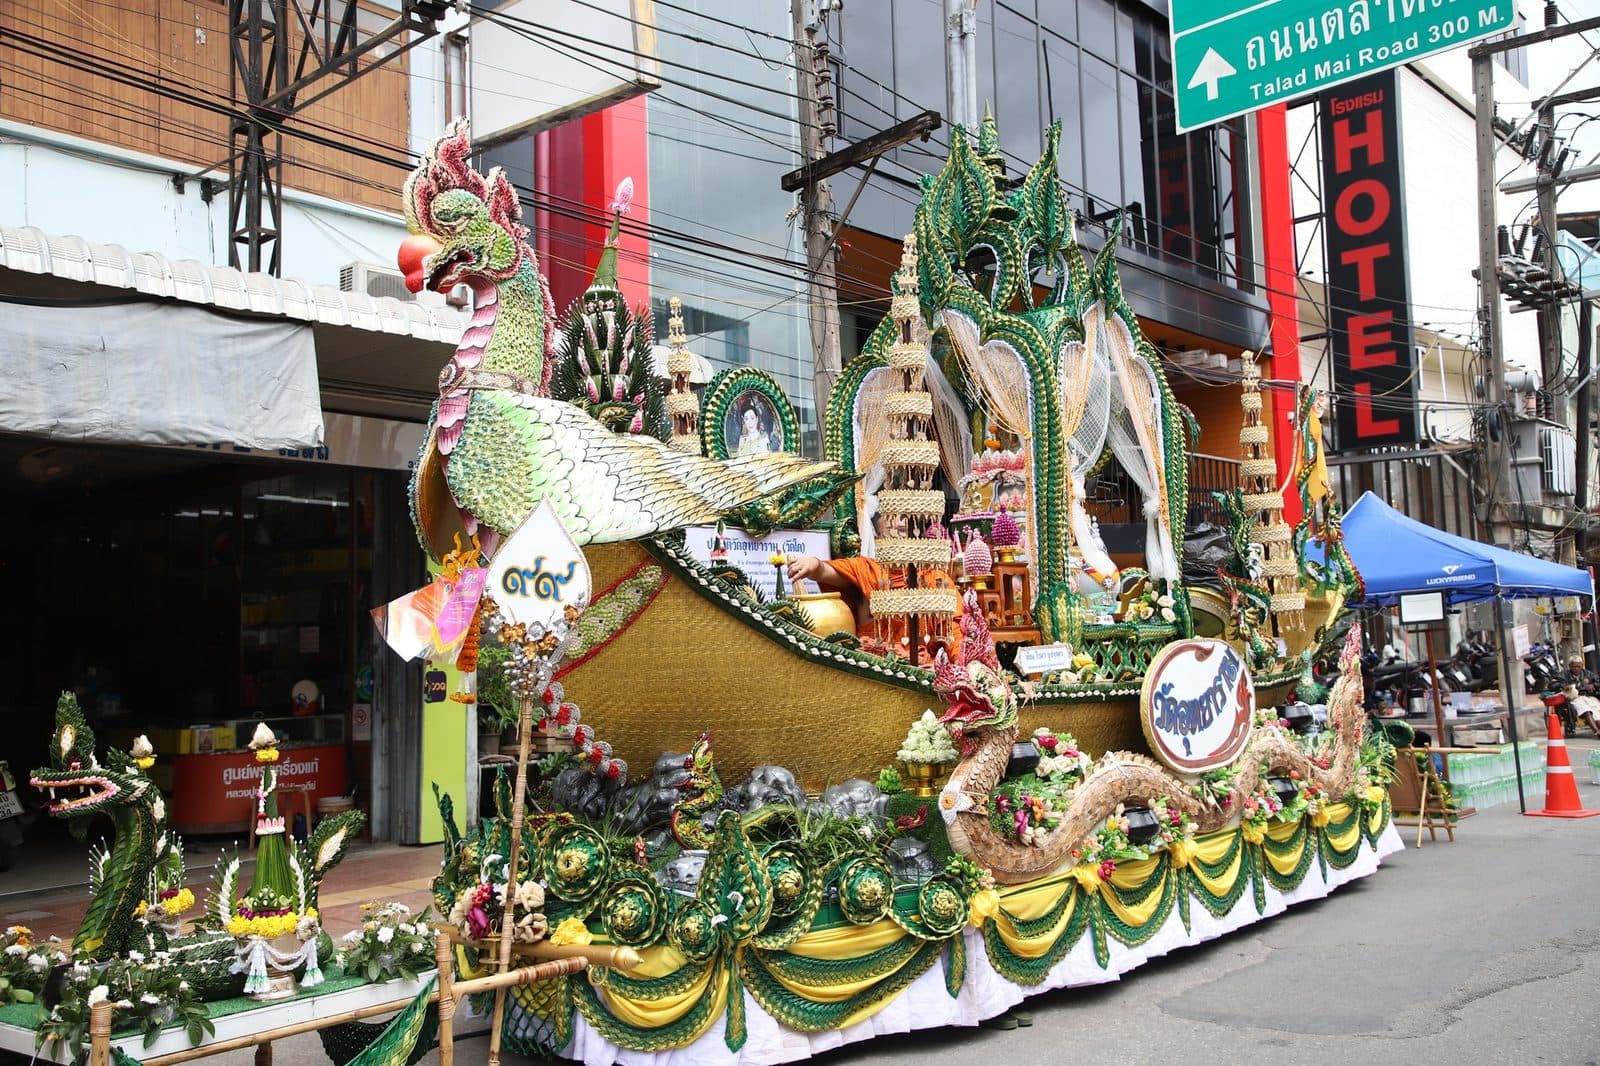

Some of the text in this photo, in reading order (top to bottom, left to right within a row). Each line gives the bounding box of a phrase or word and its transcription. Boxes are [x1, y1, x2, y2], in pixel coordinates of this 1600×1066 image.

[1250, 6, 1505, 100] Talad Mai Road 300 M.
[1330, 89, 1384, 117] โรงแรม
[1333, 109, 1399, 438] HOTEL
[1426, 574, 1476, 585] LUCKYFRIEND
